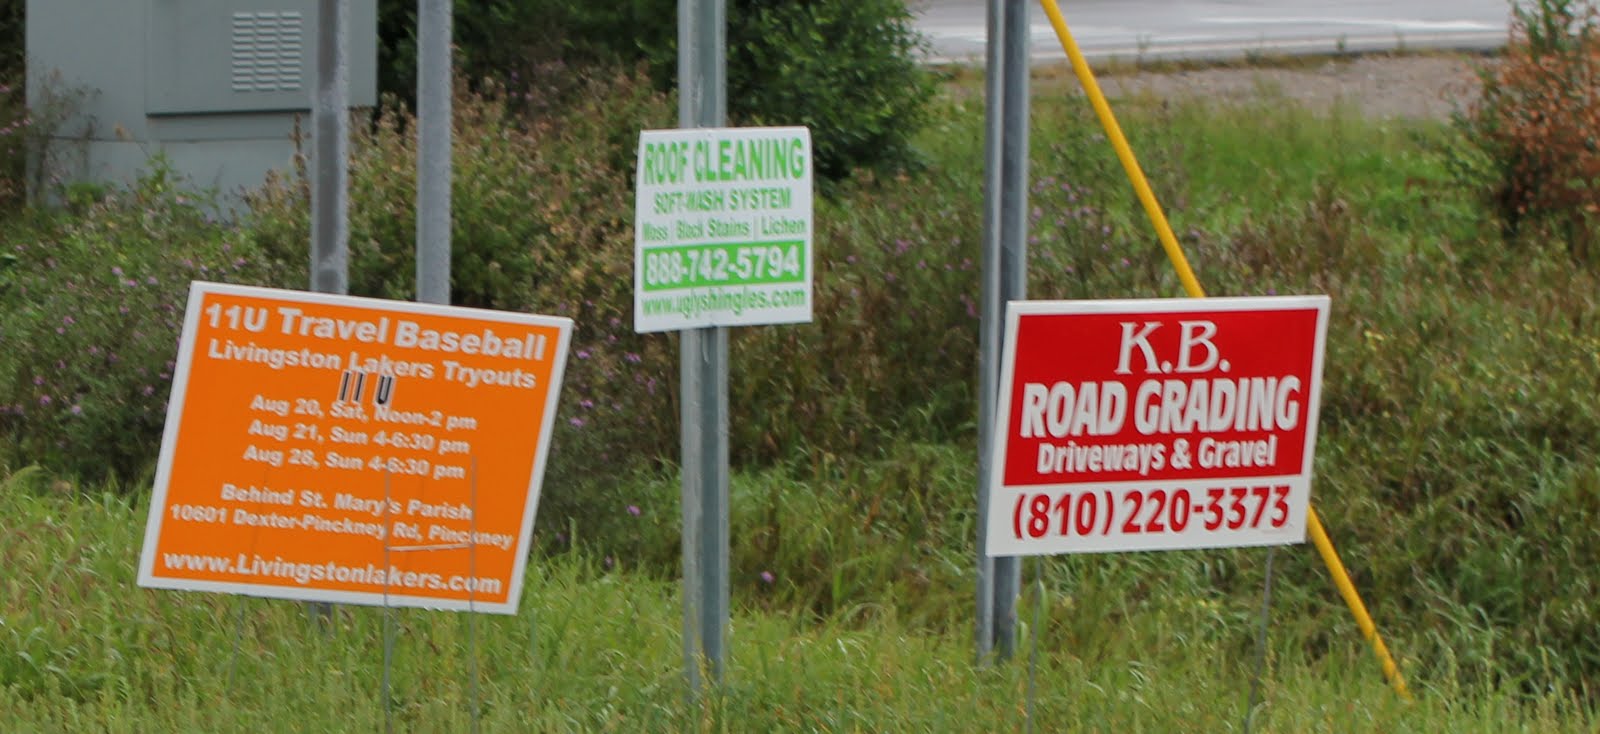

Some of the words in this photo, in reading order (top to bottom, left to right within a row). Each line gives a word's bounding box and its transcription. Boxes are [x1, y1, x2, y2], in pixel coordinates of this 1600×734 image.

[644, 140, 688, 184] ROOF
[693, 137, 805, 182] CLEANING
[653, 190, 725, 214] SOFT-WASH
[729, 186, 792, 210] SYSTEM
[707, 217, 750, 238] Stains
[761, 215, 806, 235] Lichen
[646, 245, 800, 286] 888-742-5794
[642, 286, 806, 319] www.uglyshingles.com
[204, 303, 268, 332] 11U
[277, 308, 388, 344] Travel
[394, 318, 548, 361] Baseball
[1114, 320, 1231, 375] K.B.
[207, 338, 342, 371] Livingston
[348, 351, 435, 379] Lakers
[442, 360, 537, 390] Tryouts
[250, 395, 290, 417] Aug
[294, 397, 324, 419] 20,
[330, 399, 369, 423] Sat,
[374, 404, 443, 427] Noon-2
[446, 415, 478, 431] pm
[1020, 381, 1128, 438] ROAD
[1134, 375, 1301, 435] GRADING
[248, 419, 288, 441] Aug
[292, 423, 324, 444] 21,
[330, 426, 368, 445] Sun
[373, 430, 436, 451] 4-6:30
[438, 438, 471, 455] pm
[1037, 441, 1166, 476] Driveways
[1170, 438, 1192, 470] &
[1198, 435, 1277, 468] Gravel
[243, 445, 283, 467] Aug
[288, 448, 320, 469] 28,
[325, 451, 364, 470] Sun
[368, 455, 430, 475] 4-6:30
[433, 463, 466, 480] pm
[221, 483, 294, 505] Behind
[299, 490, 328, 509] St.
[333, 493, 402, 517] Mary's
[407, 499, 474, 521] Parish
[1013, 490, 1115, 539] (810)
[1121, 485, 1291, 534] 220-3373
[171, 504, 227, 525] 10601
[233, 508, 388, 541] Dexter-Pinckney
[393, 522, 424, 542] Rd,
[428, 525, 514, 551] Pinckney
[163, 551, 504, 596] www.Livingstonlakers.com
